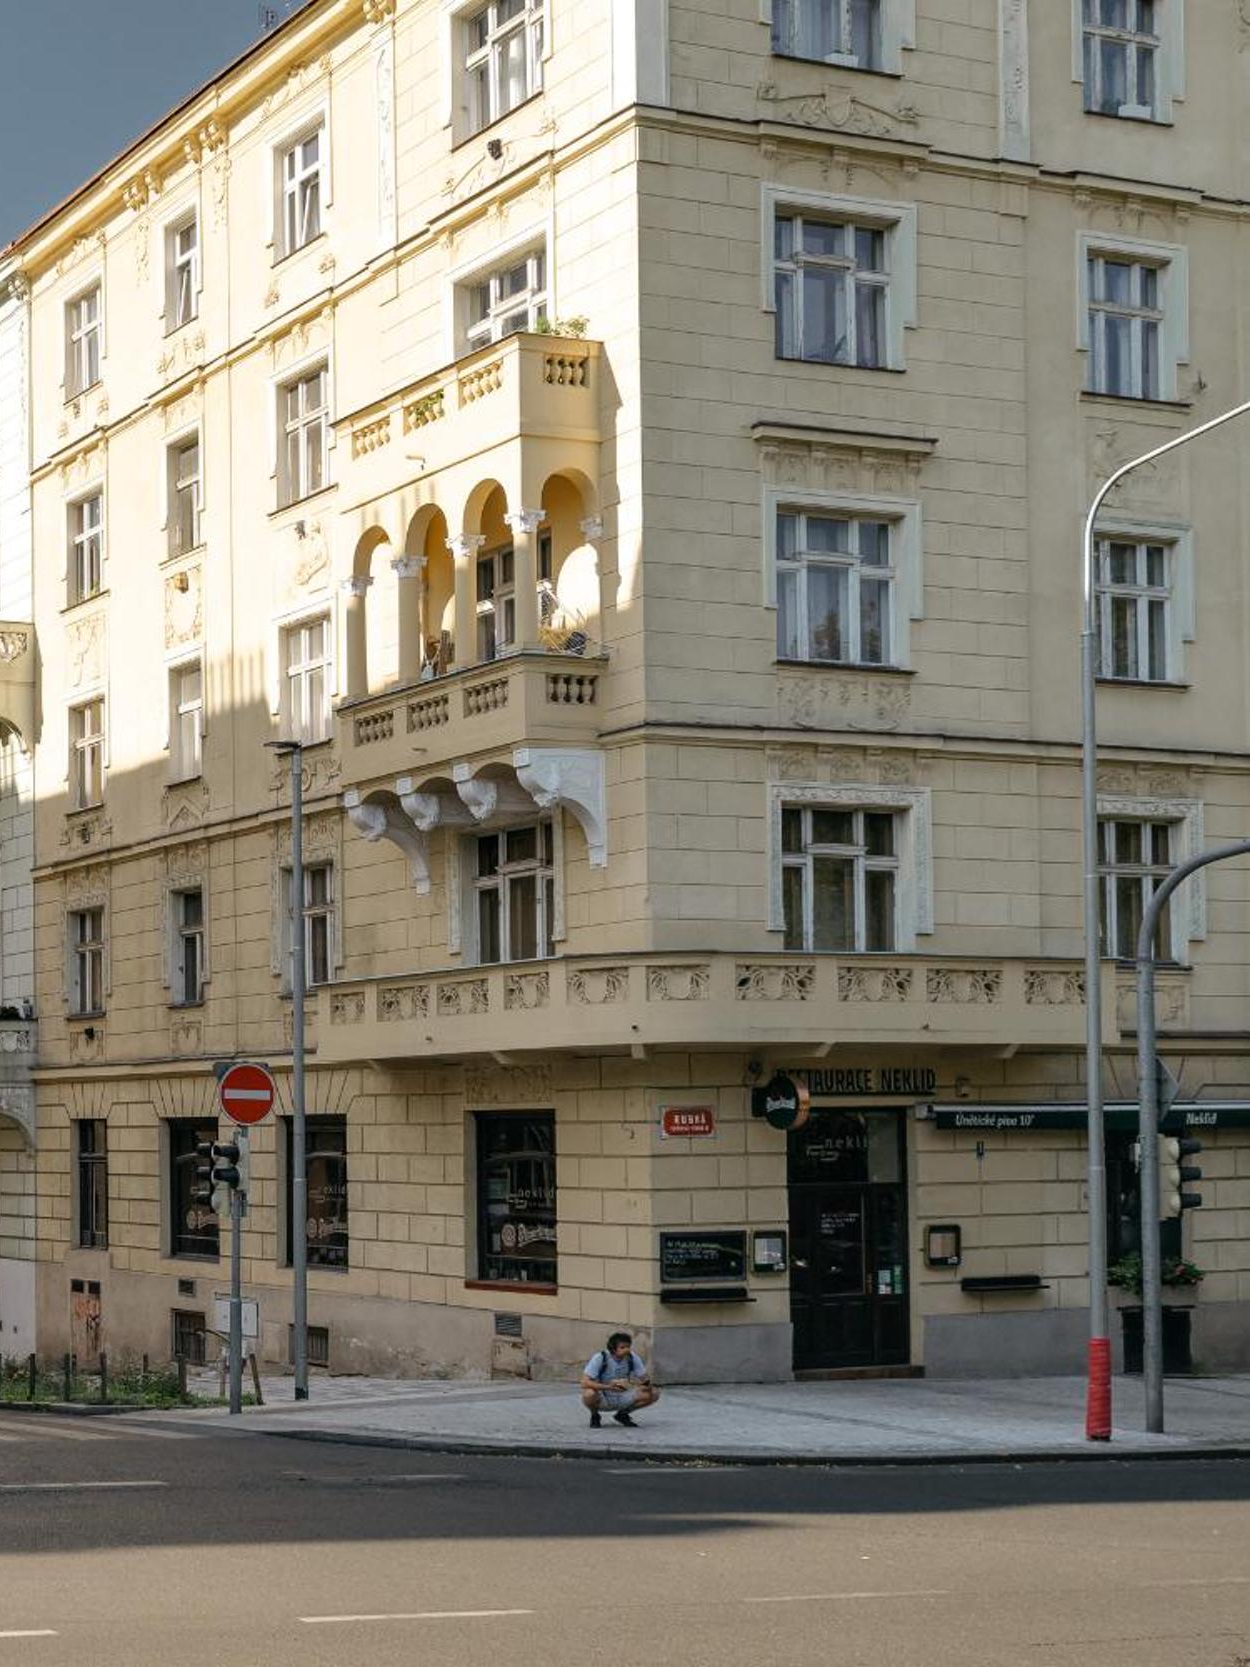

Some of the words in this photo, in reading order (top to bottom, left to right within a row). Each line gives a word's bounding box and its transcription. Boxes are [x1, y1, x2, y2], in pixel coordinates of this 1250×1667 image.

[880, 1067, 936, 1091] NEKLID
[1186, 1111, 1218, 1126] Neklid
[825, 1135, 869, 1150] nekli
